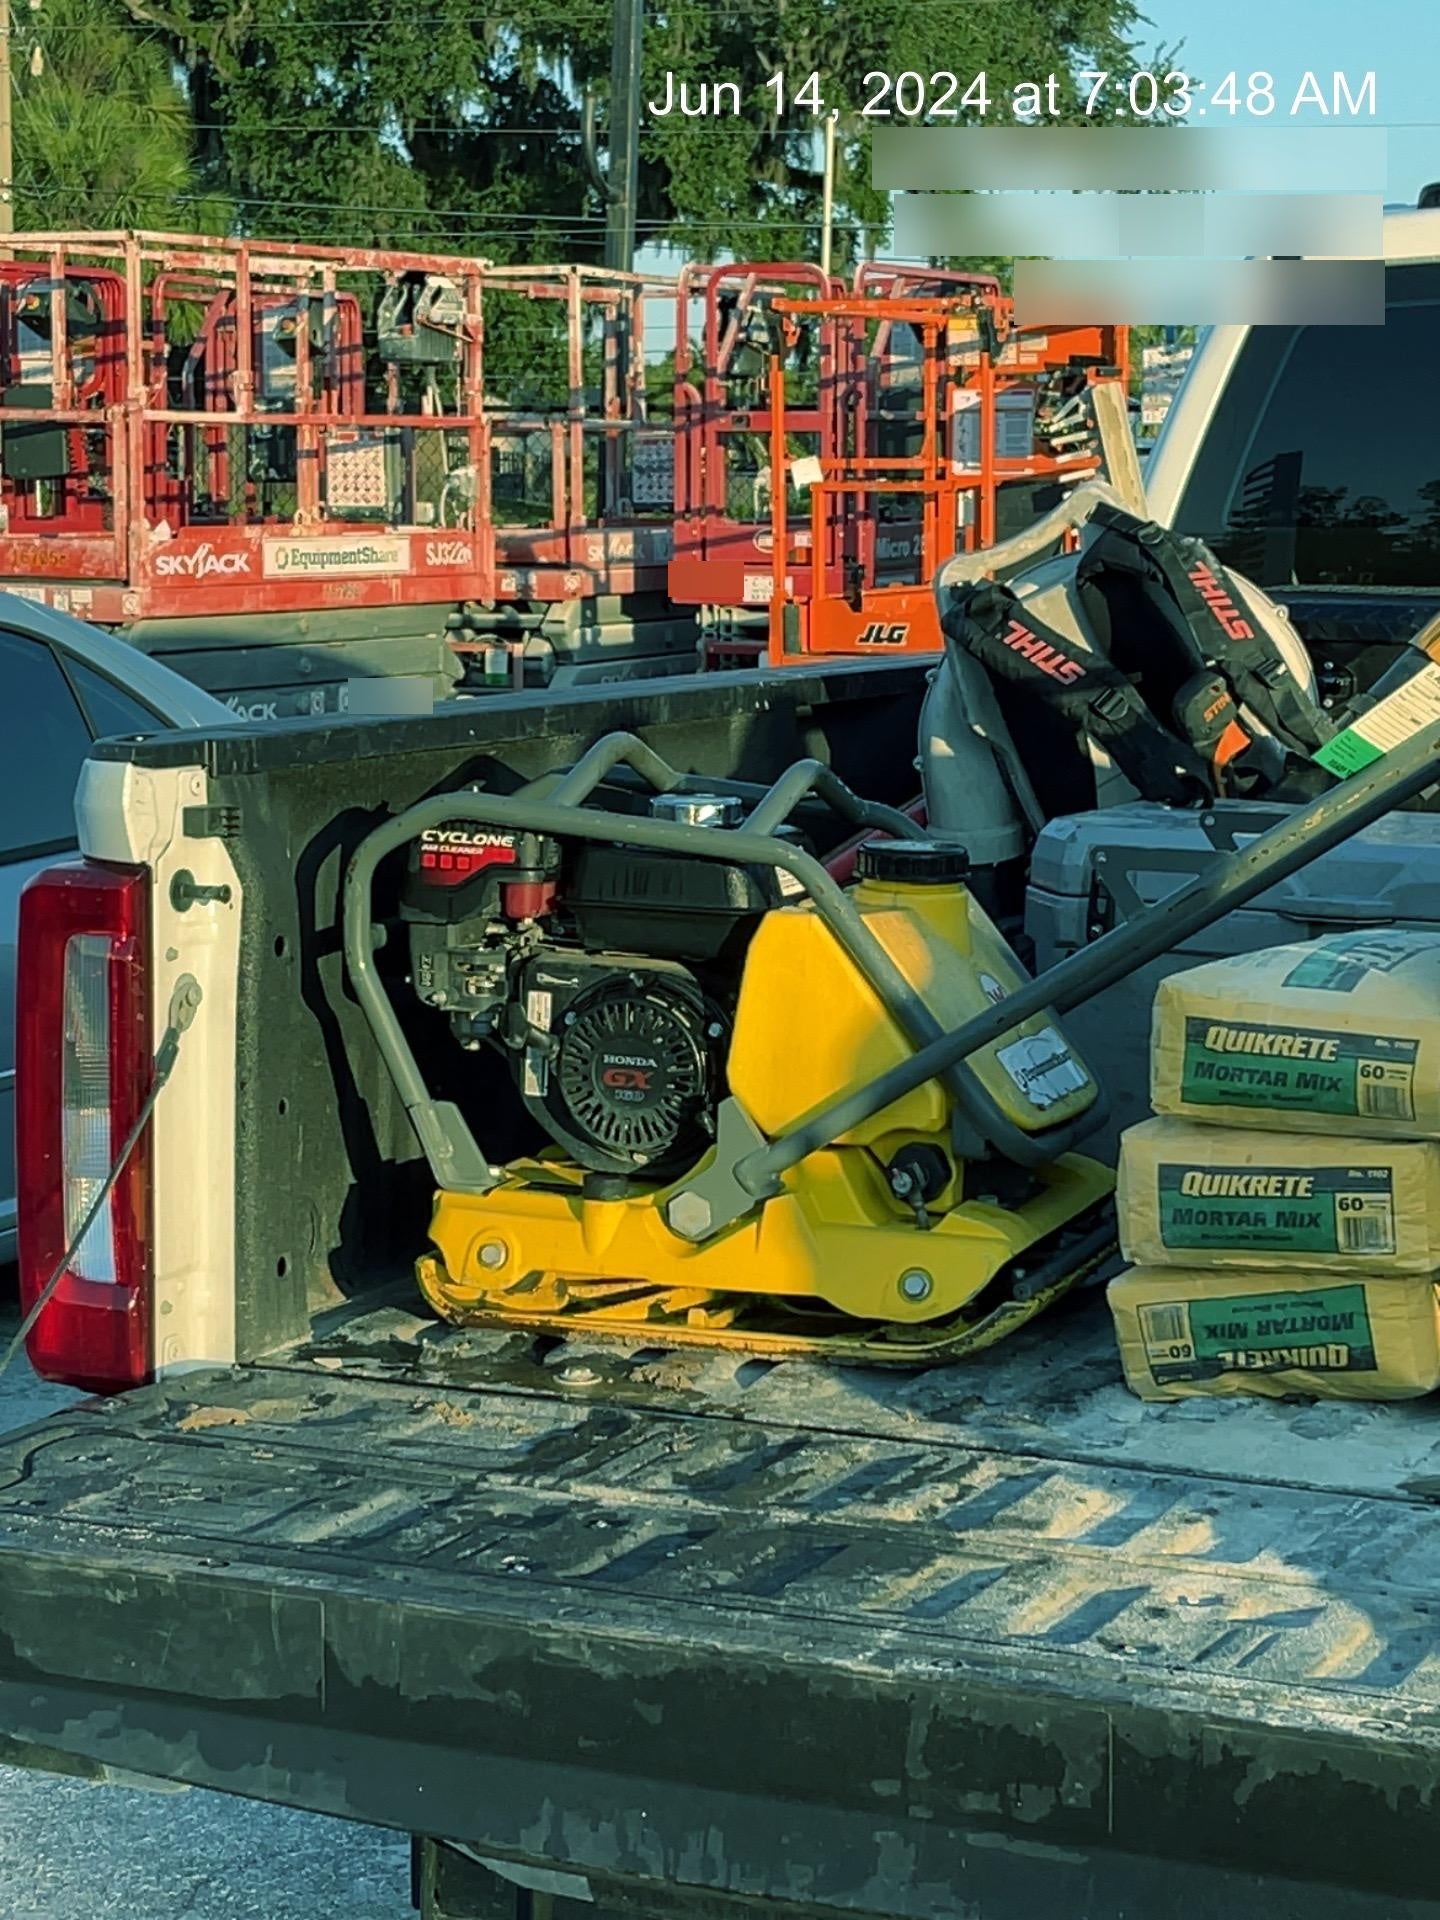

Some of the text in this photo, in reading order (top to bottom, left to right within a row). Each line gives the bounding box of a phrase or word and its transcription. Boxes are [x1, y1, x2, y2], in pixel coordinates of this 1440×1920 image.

[155, 543, 250, 579] SKYJACK
[291, 546, 400, 570] EquipmentShare
[1187, 560, 1255, 641] STIHL
[857, 624, 907, 644] JLG
[1002, 620, 1087, 686] STIHL
[421, 829, 516, 848] CYCLONE
[439, 844, 484, 856] CLEANER
[1203, 1025, 1341, 1061] QUIKRETE
[603, 1054, 658, 1068] HONDA
[1359, 1064, 1386, 1080] 60
[602, 1067, 655, 1090] GX
[1192, 1061, 1343, 1093] MORTAR MIX
[1180, 1171, 1315, 1198] QUIKRETE
[1338, 1196, 1364, 1212] 60
[1171, 1208, 1323, 1229] MORTAR MIX
[1203, 1311, 1356, 1340] MORTAR MIX
[1167, 1344, 1193, 1360] 60
